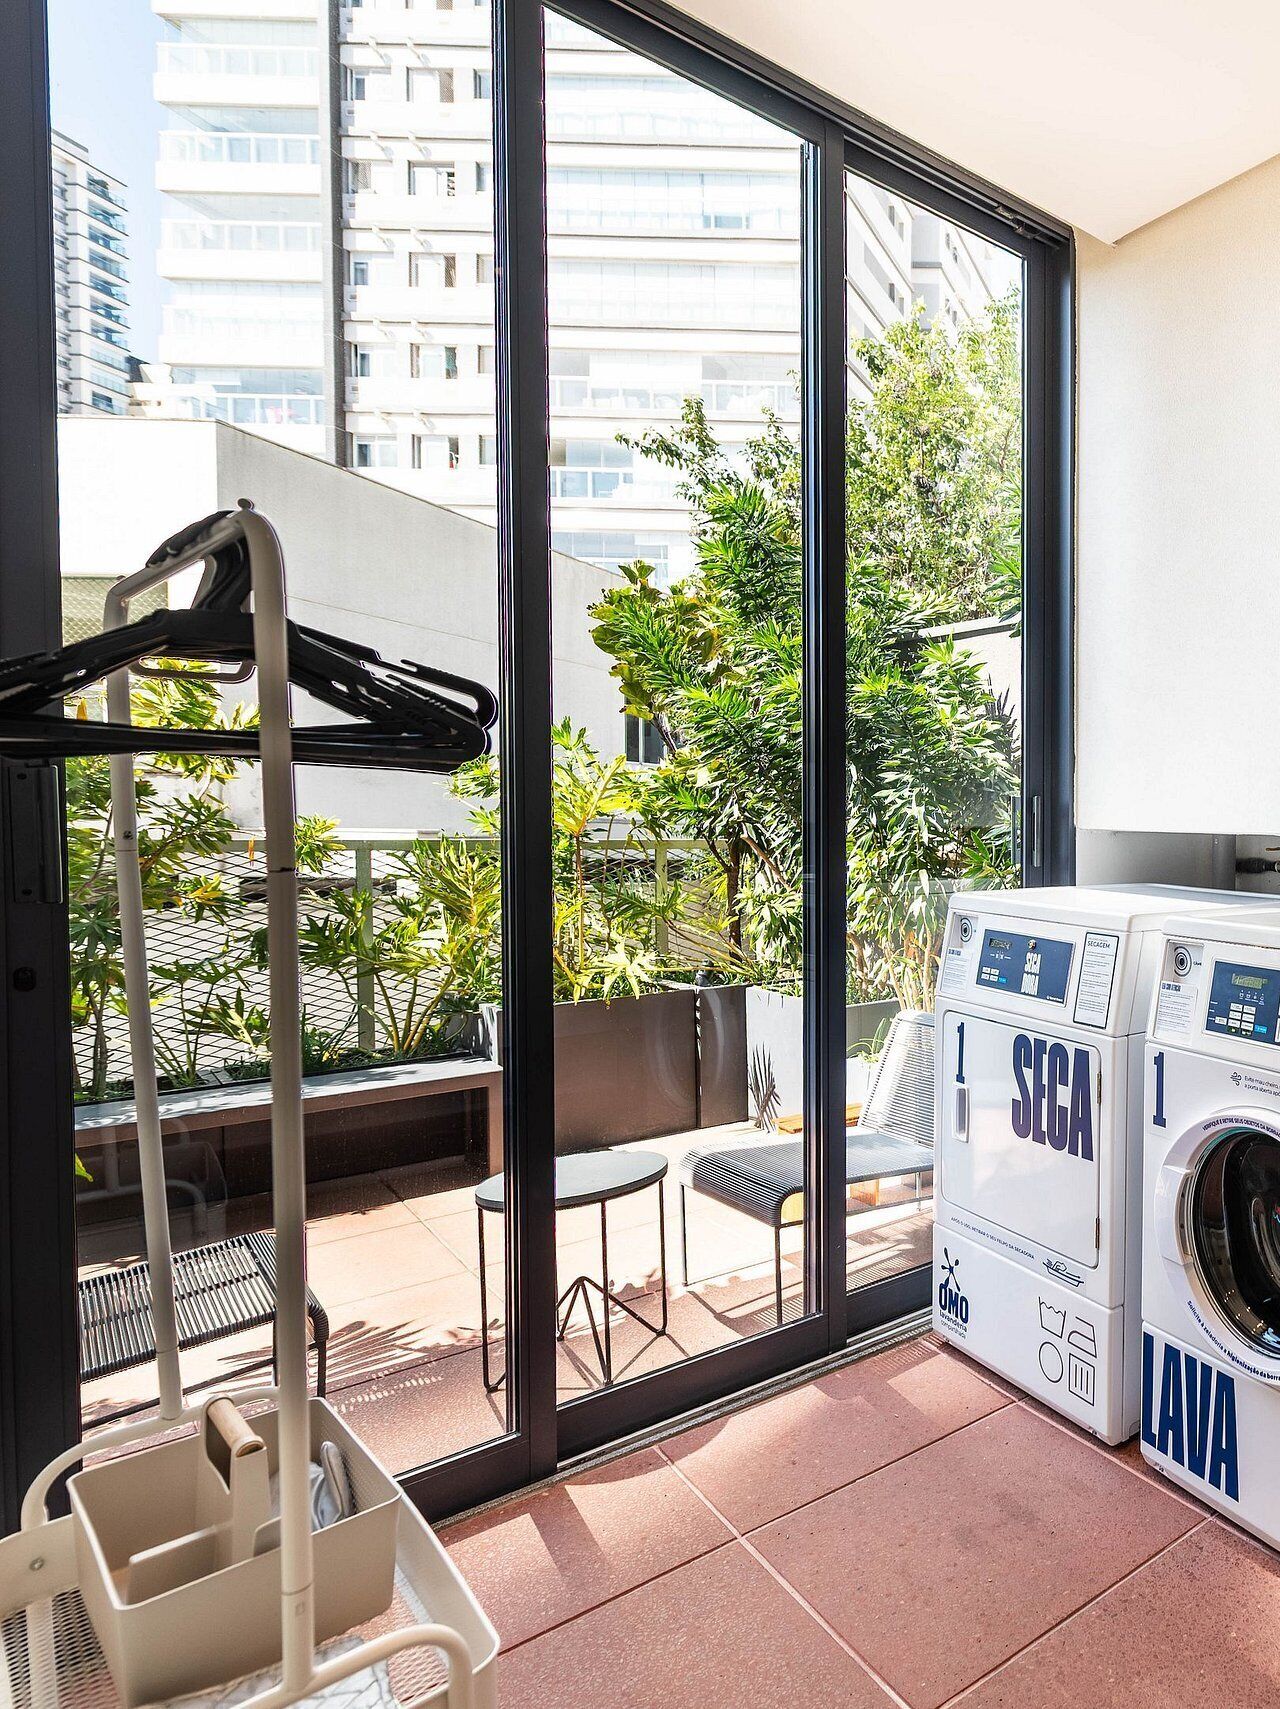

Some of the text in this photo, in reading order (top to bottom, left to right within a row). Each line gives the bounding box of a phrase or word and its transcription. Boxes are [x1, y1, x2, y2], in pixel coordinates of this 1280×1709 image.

[1024, 952, 1042, 974] SECA
[1087, 940, 1111, 949] SECAGEM
[1020, 972, 1039, 996] DORA
[957, 1022, 965, 1084] 1
[1011, 1033, 1095, 1162] SECA
[1154, 1051, 1167, 1128] 1
[938, 1282, 969, 1324] OMO
[939, 1309, 968, 1332] lavanderia
[1186, 1300, 1201, 1323] Solicite
[1203, 1326, 1224, 1351] zeladoria
[1259, 1371, 1267, 1379] da
[1141, 1330, 1240, 1503] LAVA
